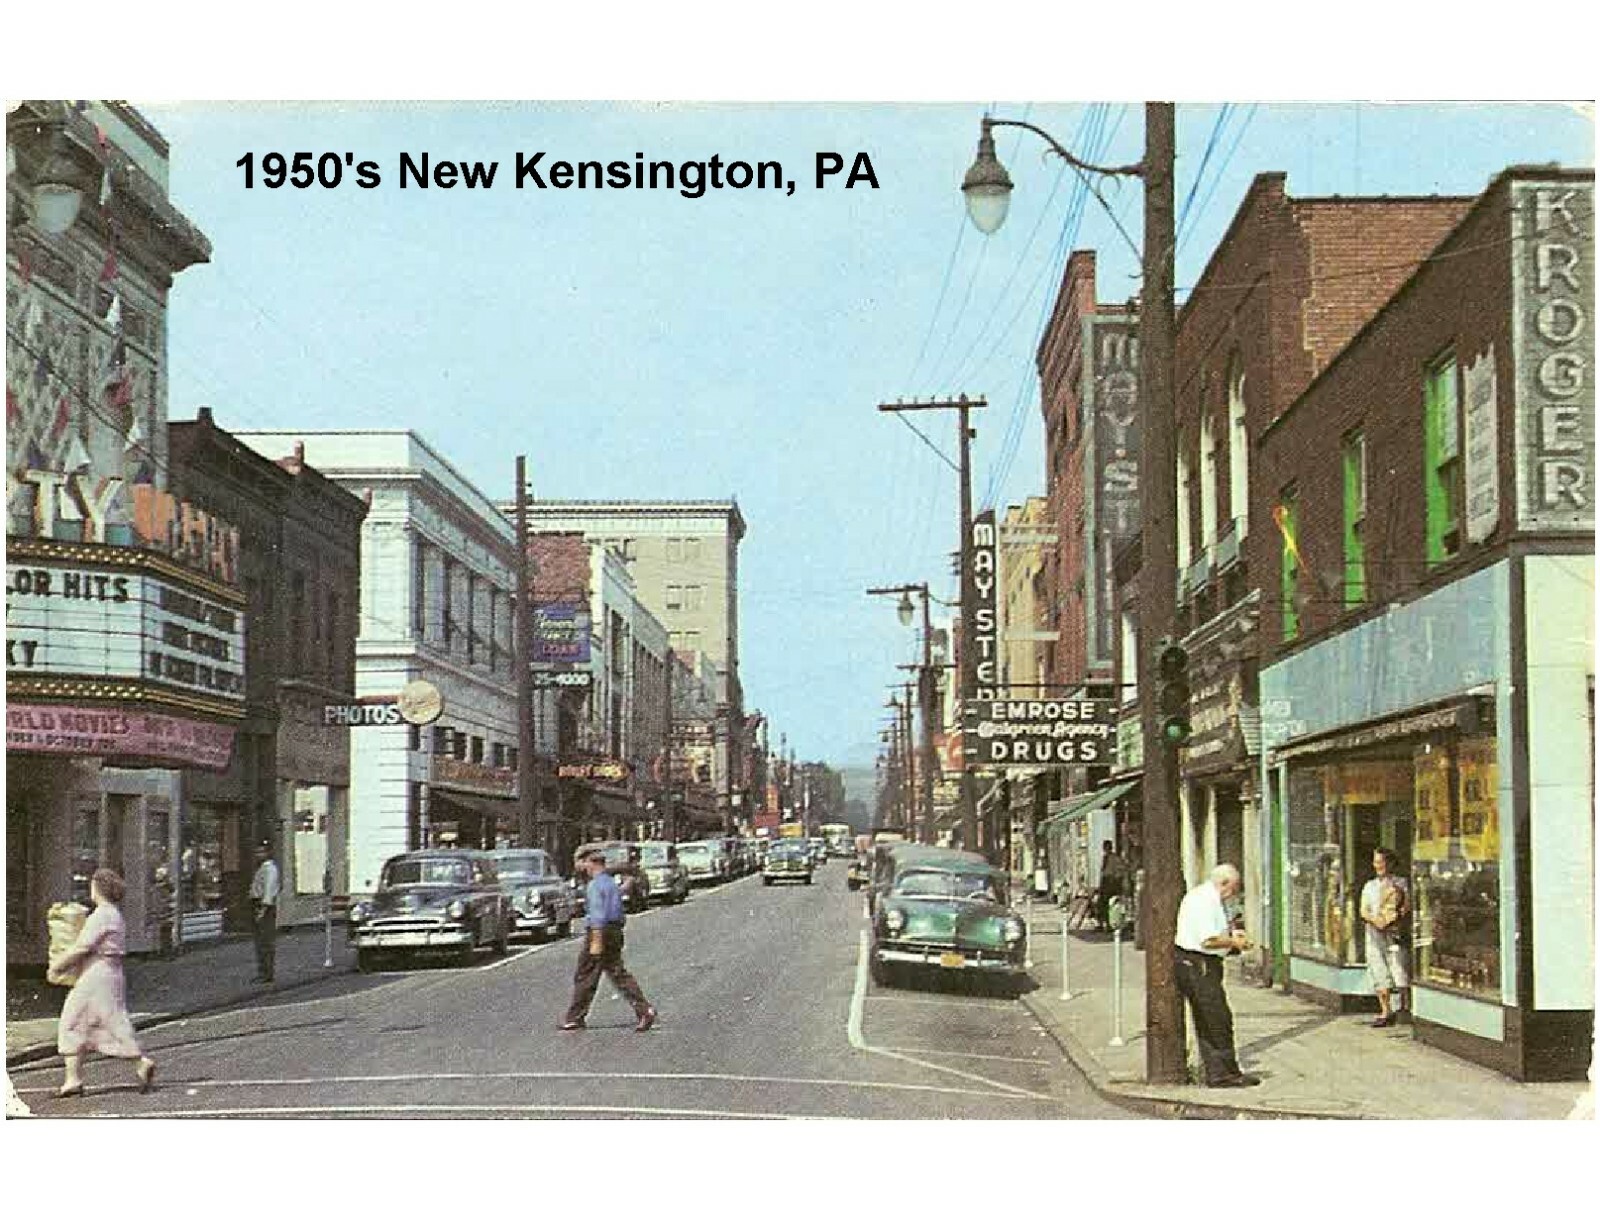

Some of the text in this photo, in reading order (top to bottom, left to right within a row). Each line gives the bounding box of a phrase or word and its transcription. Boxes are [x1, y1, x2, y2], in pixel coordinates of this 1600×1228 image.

[1535, 189, 1586, 510] KROGER
[973, 523, 994, 598] MAY
[64, 572, 129, 603] HITS
[325, 704, 400, 724] PHOTOS
[991, 741, 1098, 762] DRUGS
